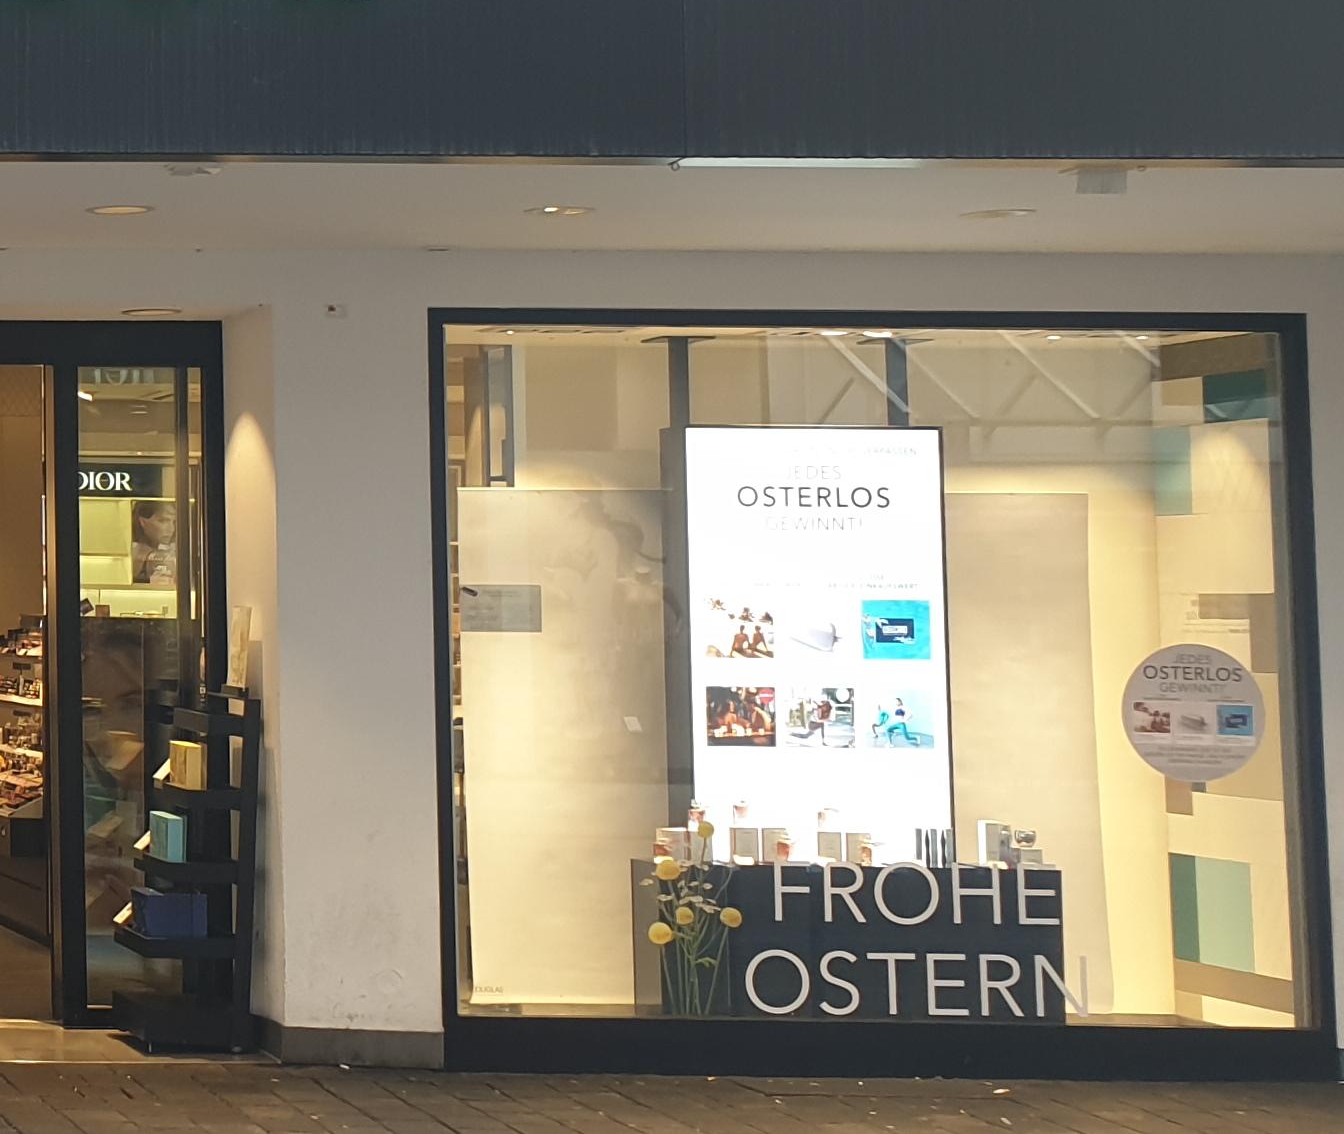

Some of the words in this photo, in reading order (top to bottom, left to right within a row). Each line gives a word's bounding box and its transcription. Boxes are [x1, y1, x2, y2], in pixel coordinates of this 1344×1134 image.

[737, 486, 891, 508] OSTERLOS
[1142, 665, 1243, 682] OSTERLOS
[773, 861, 1062, 926] FROHE
[744, 949, 1089, 1017] OSTERN
